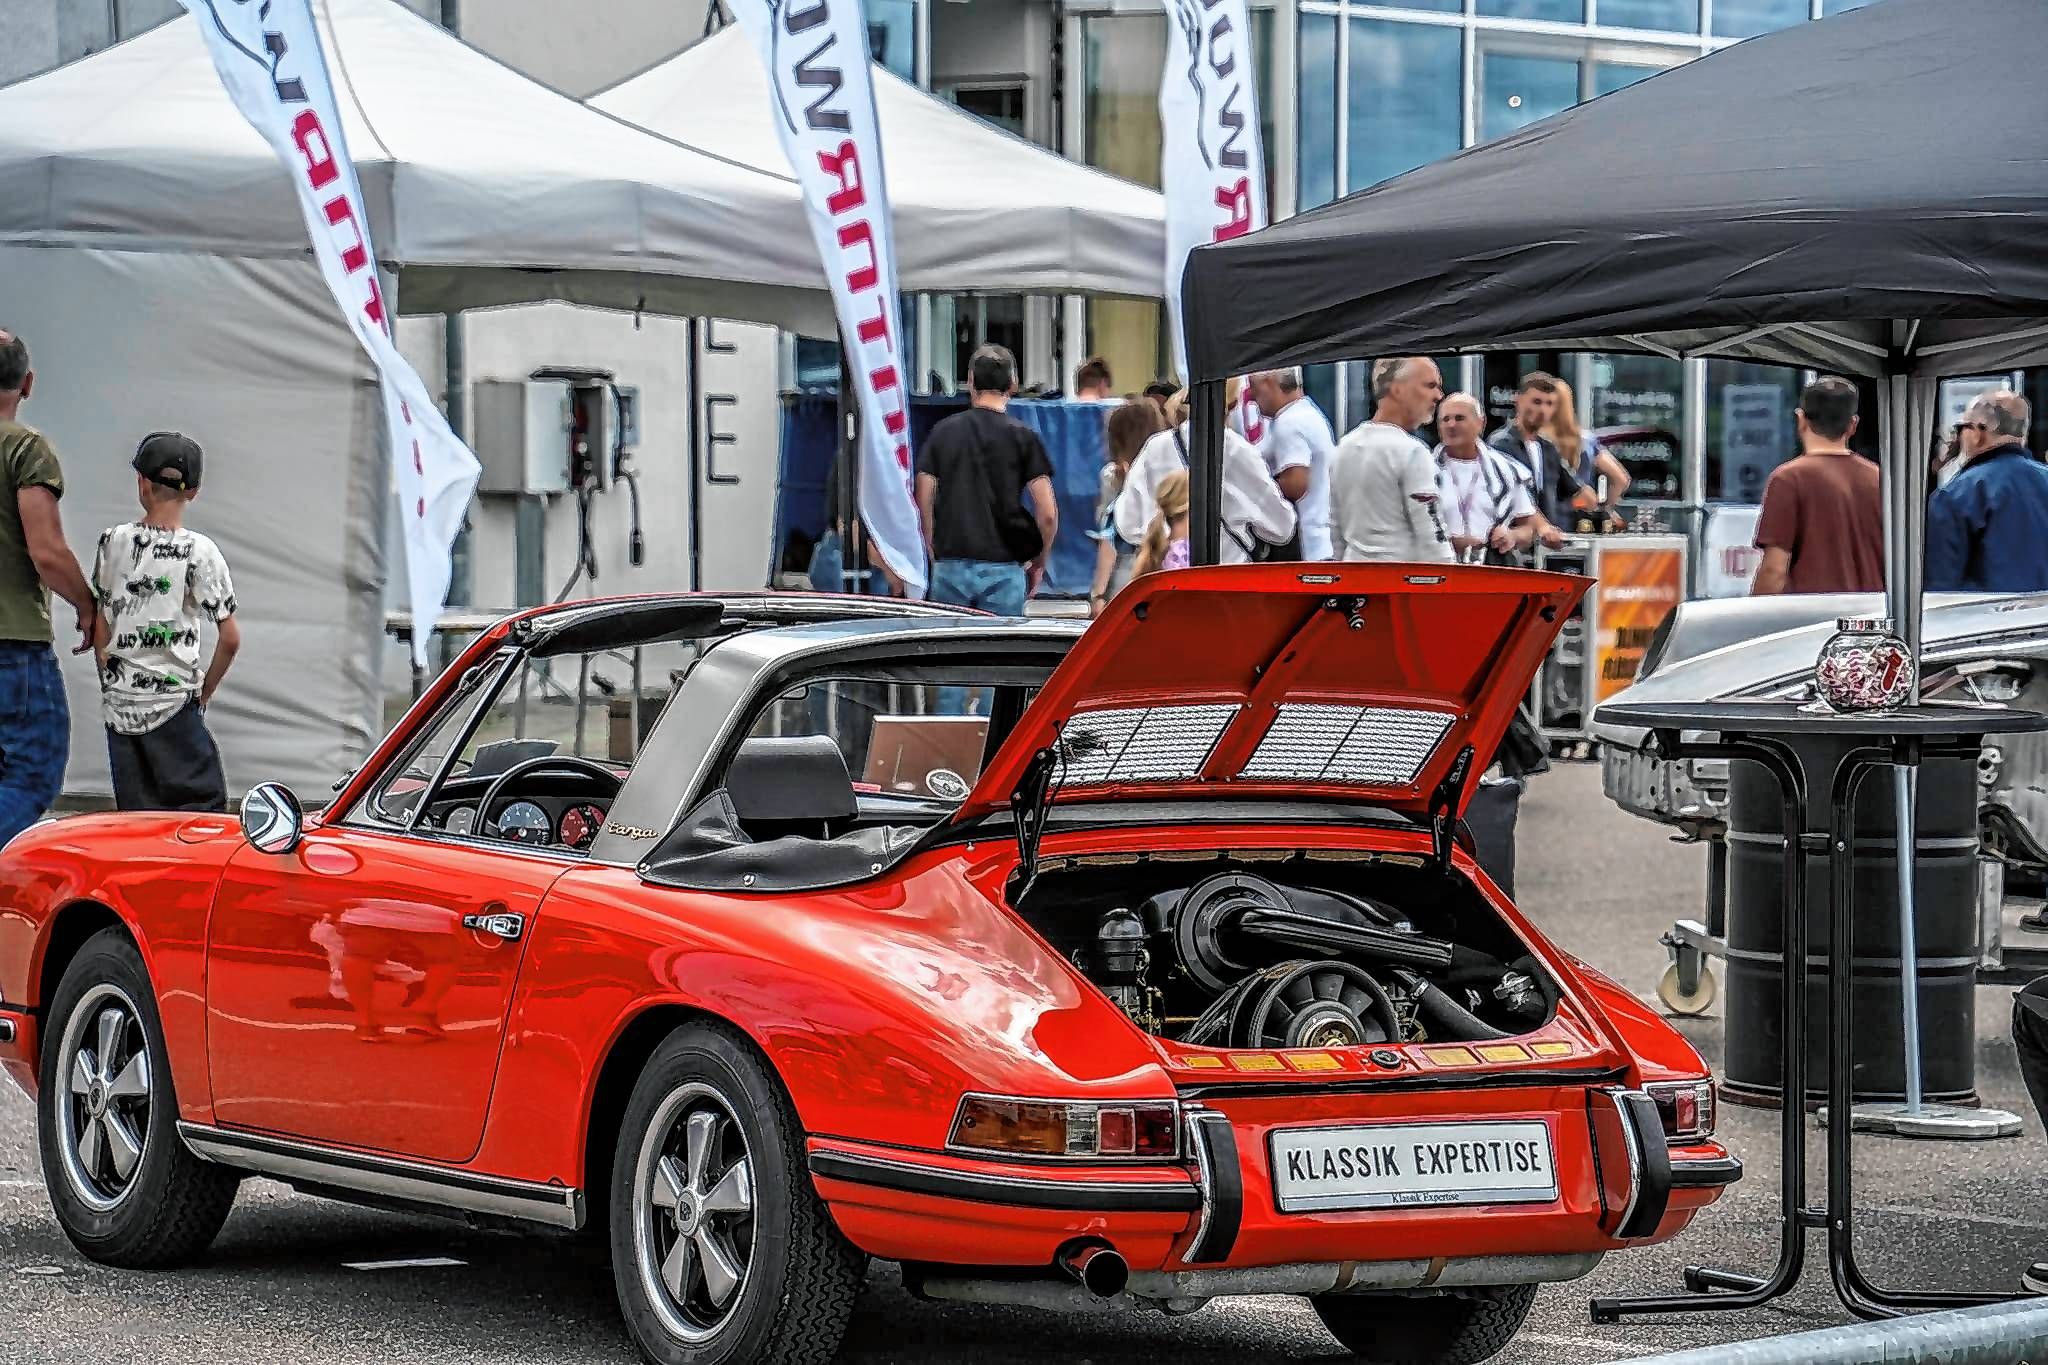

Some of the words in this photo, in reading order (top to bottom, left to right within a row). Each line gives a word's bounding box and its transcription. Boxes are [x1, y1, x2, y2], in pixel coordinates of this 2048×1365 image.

[607, 822, 658, 841] targa
[1287, 1146, 1400, 1180] KLASSIK
[1413, 1142, 1541, 1174] EXPERTISE
[1423, 1191, 1460, 1202] Expertise
